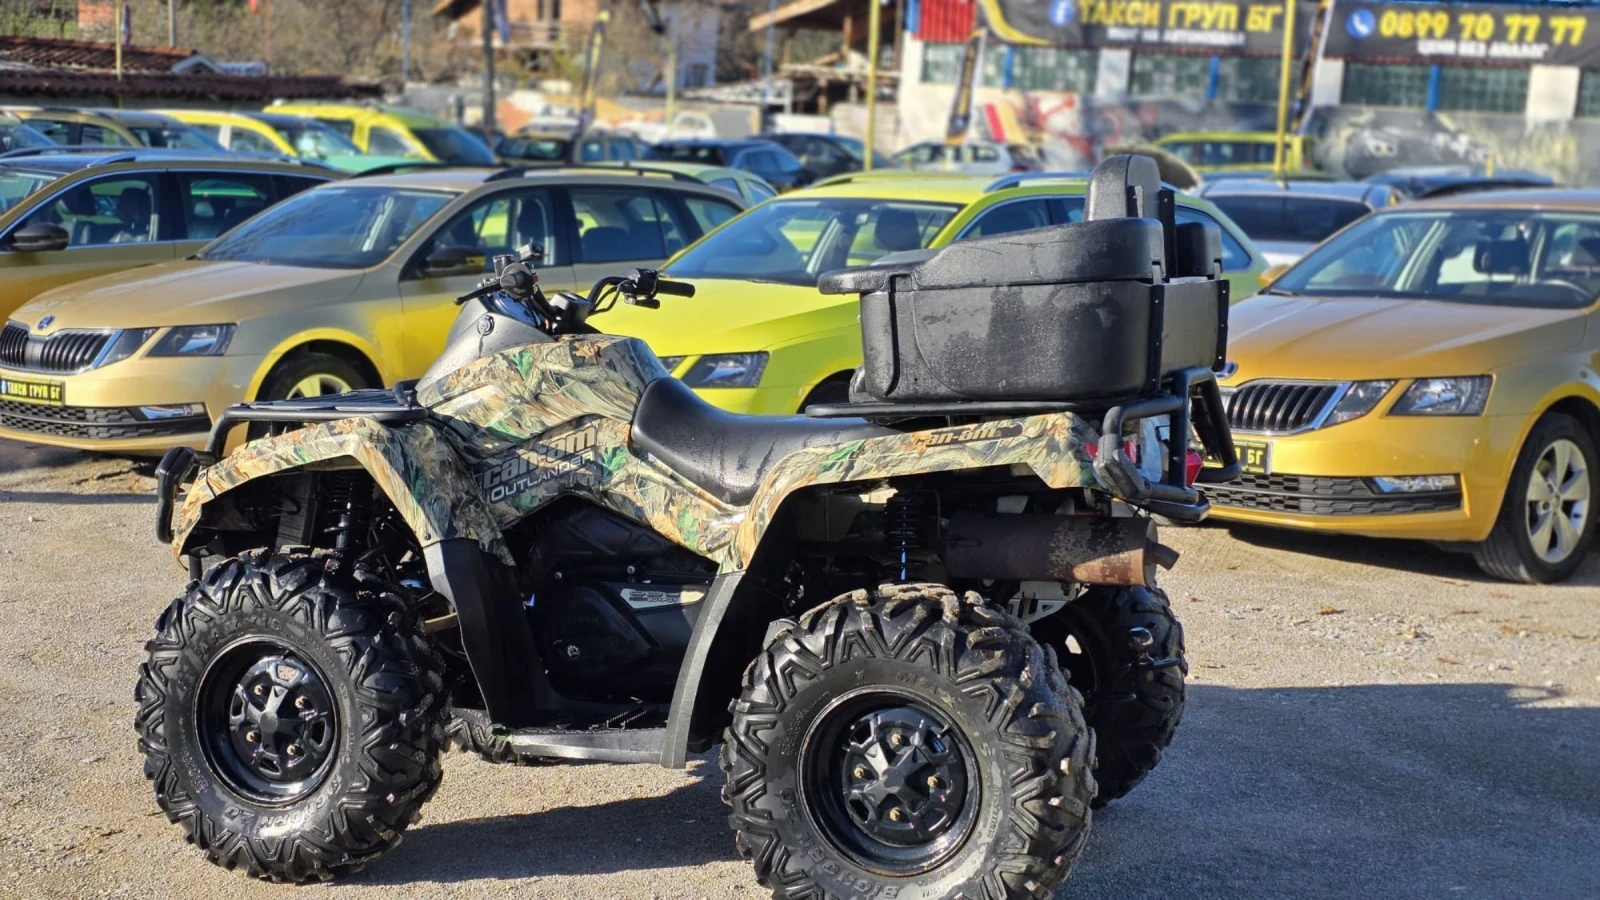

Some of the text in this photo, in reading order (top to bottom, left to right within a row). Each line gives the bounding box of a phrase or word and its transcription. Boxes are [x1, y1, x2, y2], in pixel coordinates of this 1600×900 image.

[1078, 0, 1284, 33] ТАКСИ ГРУП БГ
[1379, 9, 1587, 46] 0899 70 77 77
[7, 381, 61, 400] ТАКСИ ГРУП БГ
[1247, 448, 1263, 466] БГ
[490, 450, 596, 502] OUTLANDER
